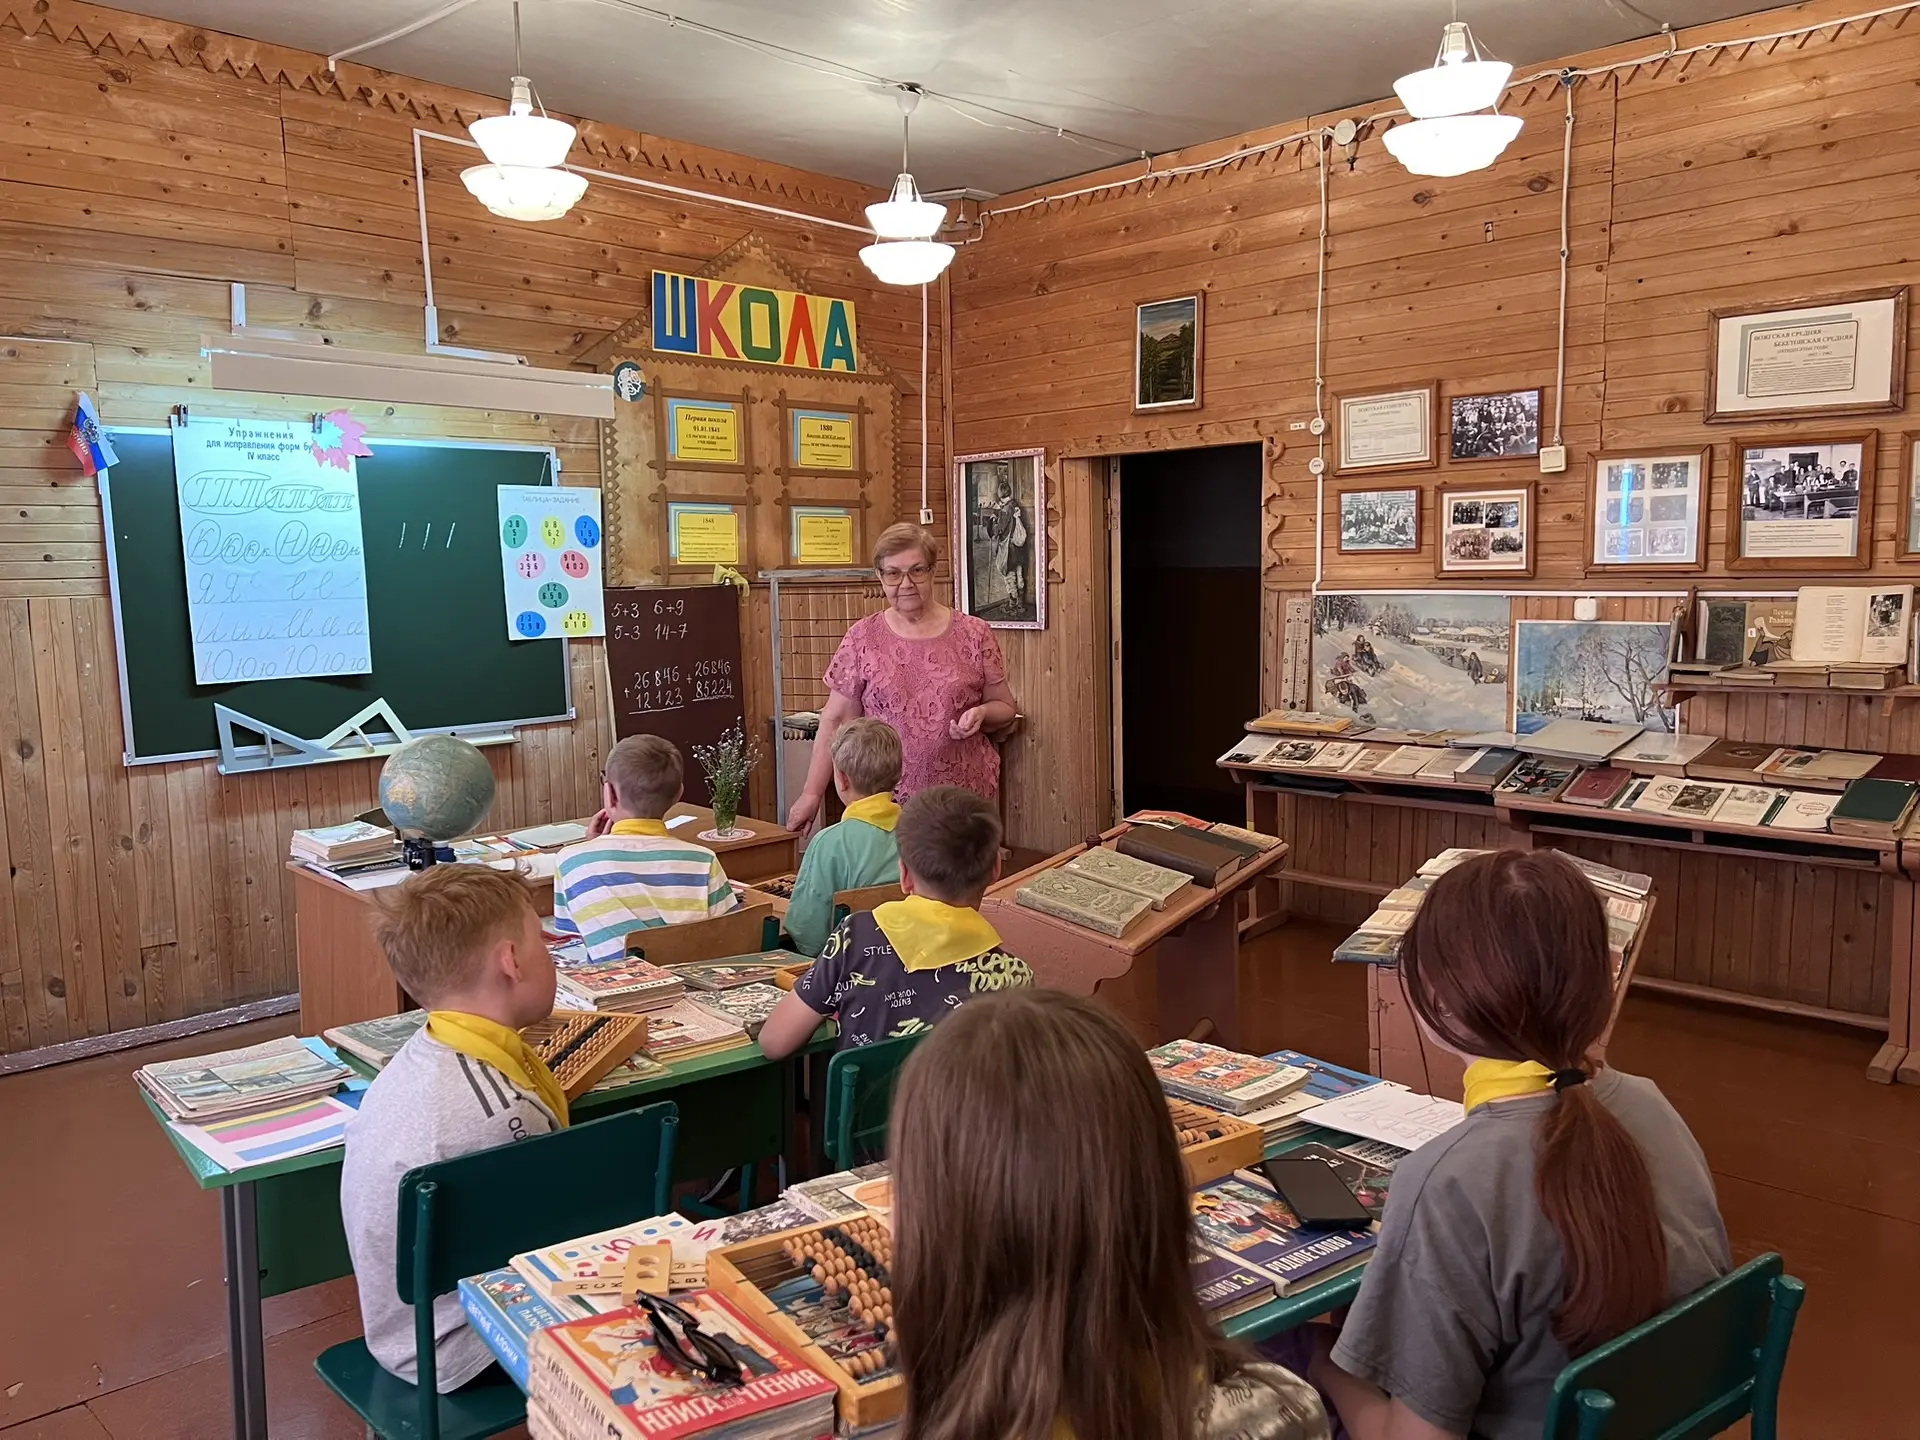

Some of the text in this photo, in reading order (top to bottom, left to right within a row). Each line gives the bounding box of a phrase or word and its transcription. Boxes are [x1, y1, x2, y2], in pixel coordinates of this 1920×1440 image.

[653, 271, 857, 371] ШКОЛА
[228, 427, 294, 440] Упражнения
[206, 440, 221, 449] для
[224, 440, 275, 451] исправления
[277, 442, 300, 452] форм
[257, 453, 280, 461] класс
[863, 945, 892, 956] STYLE
[954, 961, 979, 973] the
[1265, 1246, 1319, 1274] РОДНОЕ
[1314, 1235, 1353, 1256] СЛОВО
[637, 1396, 722, 1433] КНИГА
[736, 1368, 824, 1402] ЧТЕНИЯ
